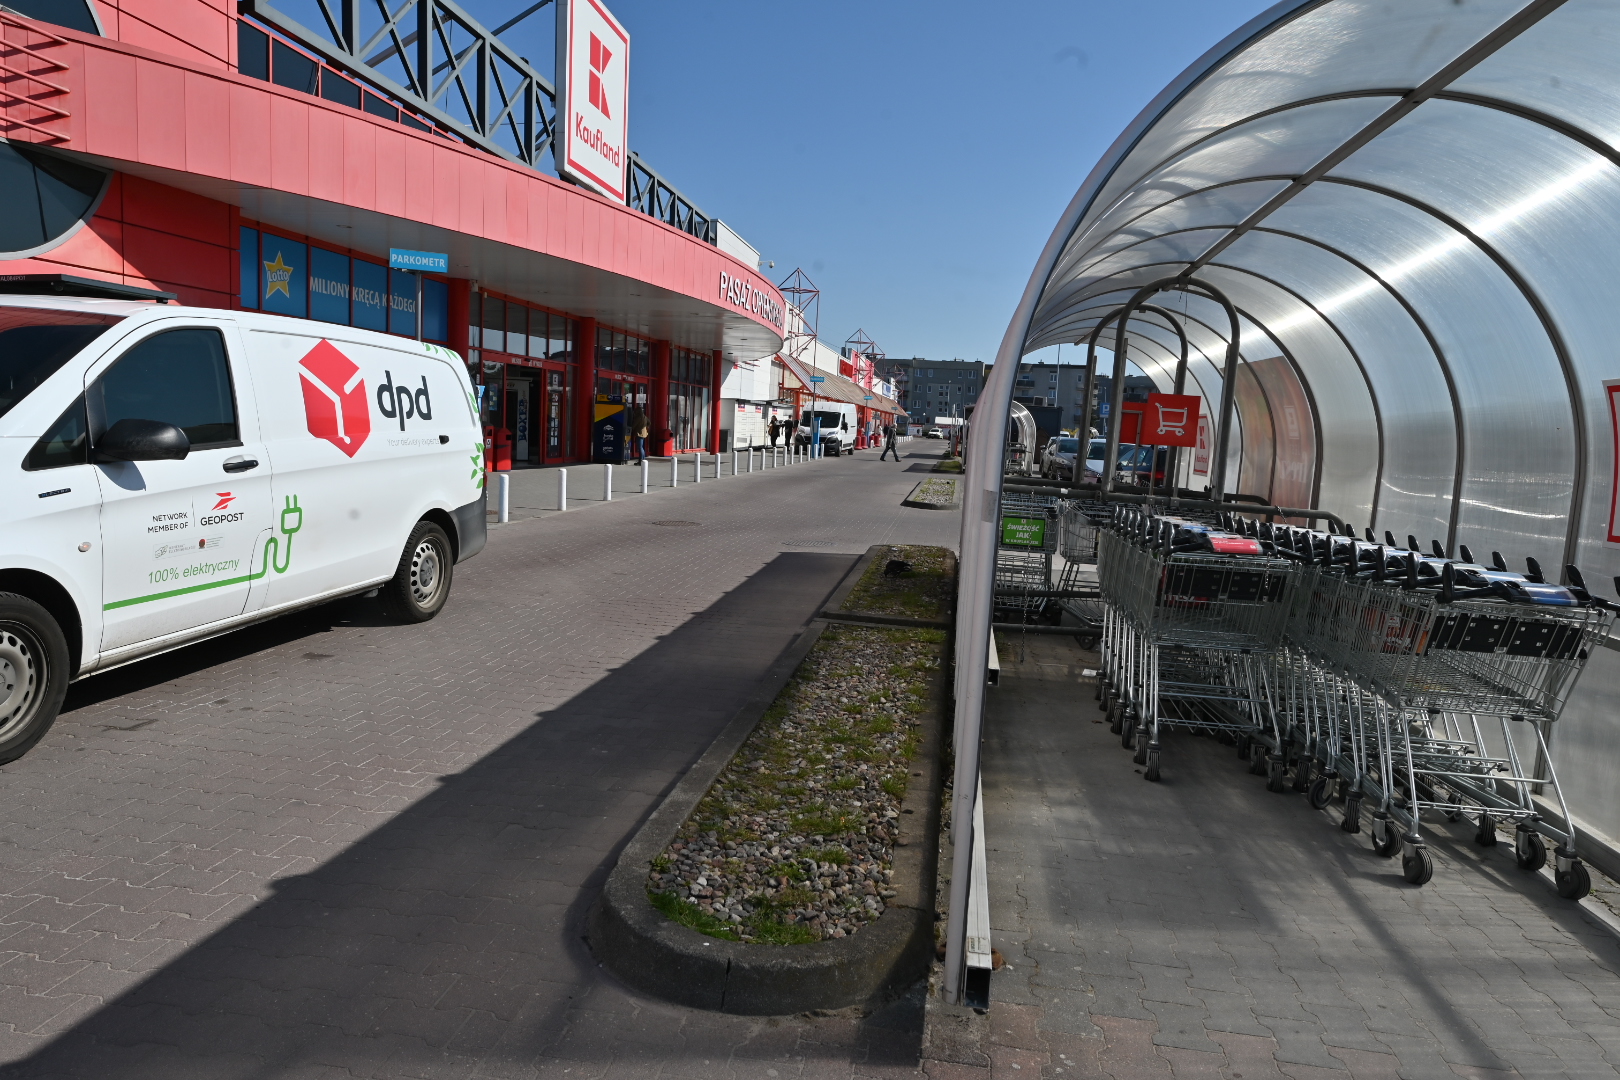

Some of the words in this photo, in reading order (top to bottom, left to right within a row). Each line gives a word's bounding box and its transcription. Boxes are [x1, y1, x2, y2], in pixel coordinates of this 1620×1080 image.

[575, 112, 620, 168] Kaufland
[391, 254, 446, 268] PARKOMETR
[267, 269, 289, 282] Lotto
[309, 276, 350, 299] MILIONY
[352, 286, 380, 309] KRĘCĄ
[719, 271, 752, 311] PASAŻ
[377, 370, 432, 431] dpd
[152, 511, 188, 522] NETWORK
[200, 512, 244, 527] GEOPOST
[147, 523, 179, 534] MEMBER
[179, 521, 189, 530] OF
[1007, 523, 1039, 531] ŚWIEŻOŚĆ
[148, 567, 180, 584] 100%
[182, 559, 240, 578] elektryczny
